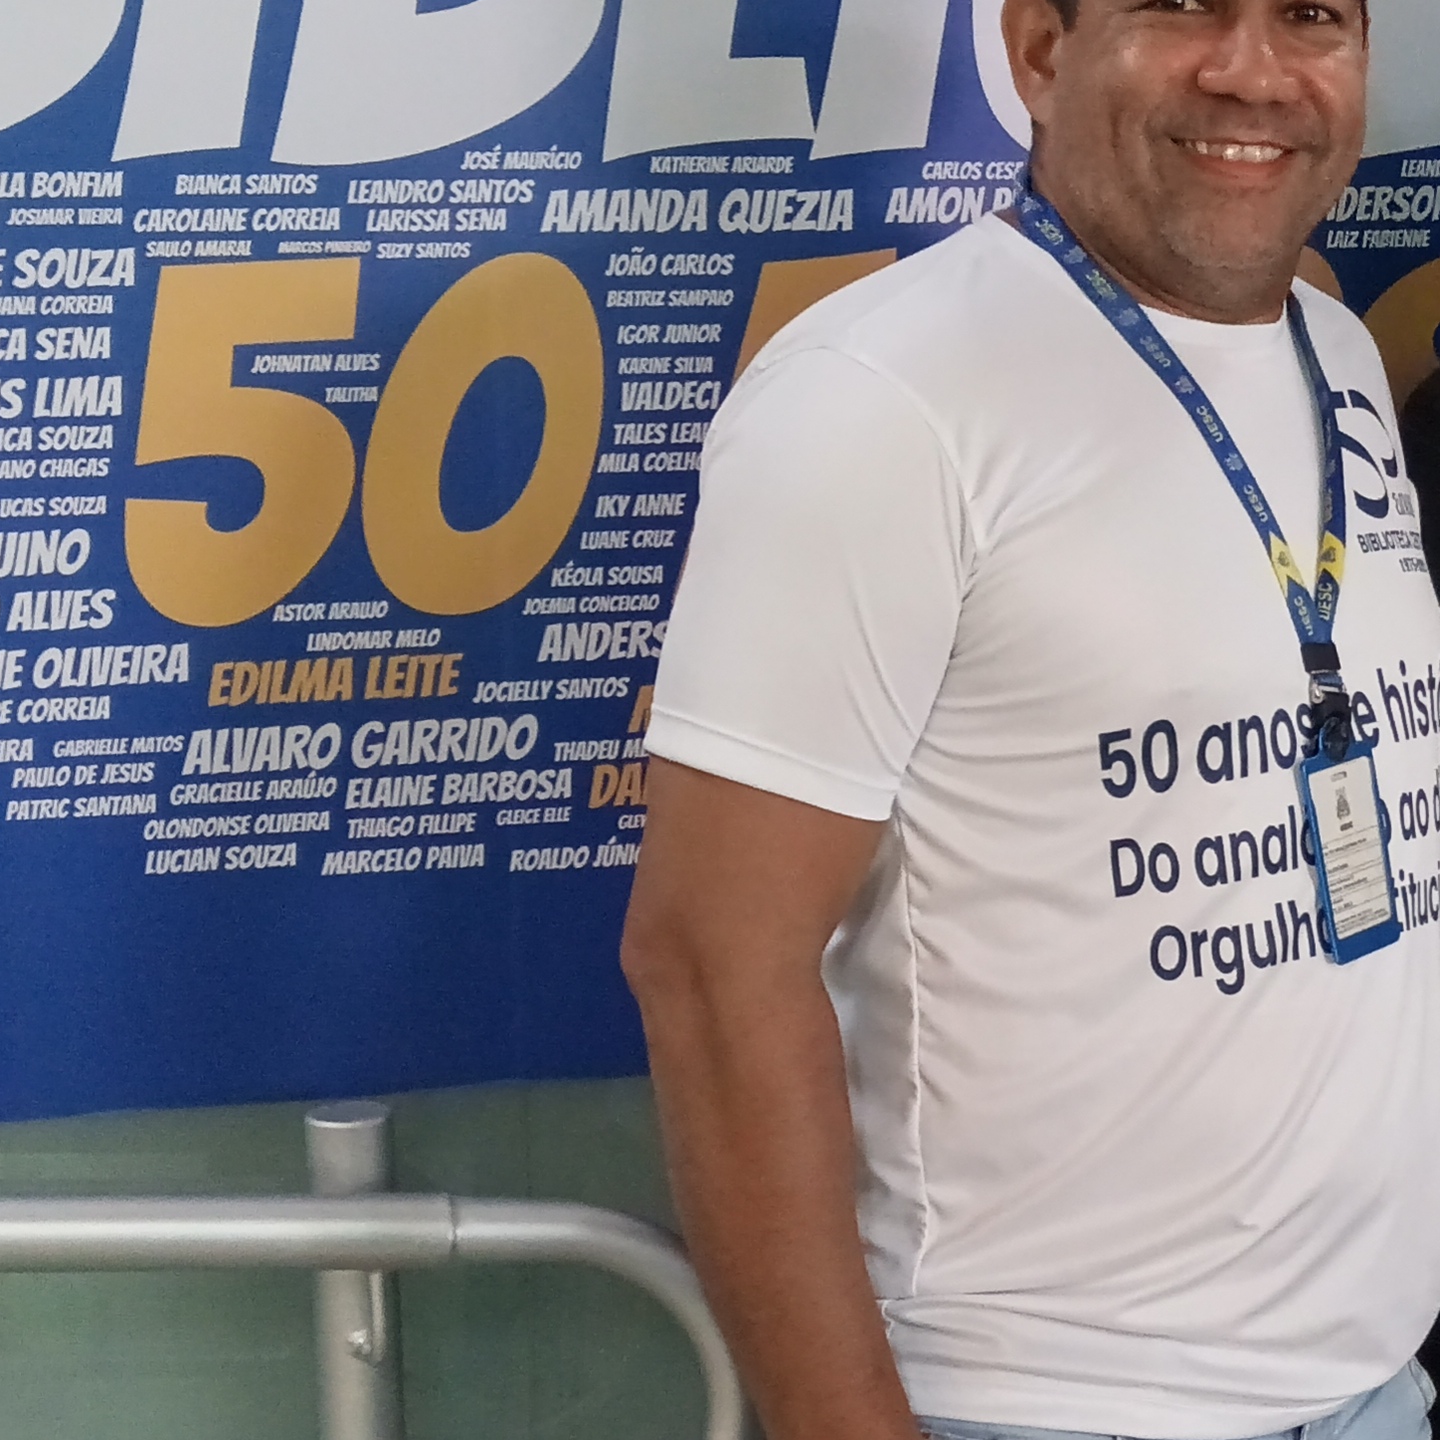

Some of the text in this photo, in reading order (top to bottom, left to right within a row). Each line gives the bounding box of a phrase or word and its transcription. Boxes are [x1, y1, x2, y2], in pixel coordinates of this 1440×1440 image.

[541, 189, 853, 233] AMANDA QUEZIA
[123, 251, 606, 629] 50
[1195, 405, 1225, 444] UESC
[1242, 484, 1269, 523] UESC
[1318, 581, 1334, 621] UESC
[208, 653, 463, 706] EDILMA LEITE
[182, 714, 538, 775] ALVARO GARRIDO
[1098, 718, 1179, 799] 50
[1350, 690, 1379, 748] e
[145, 843, 296, 874] LUCIAN SOUZA
[1109, 838, 1180, 898] Do
[1399, 787, 1430, 841] ao
